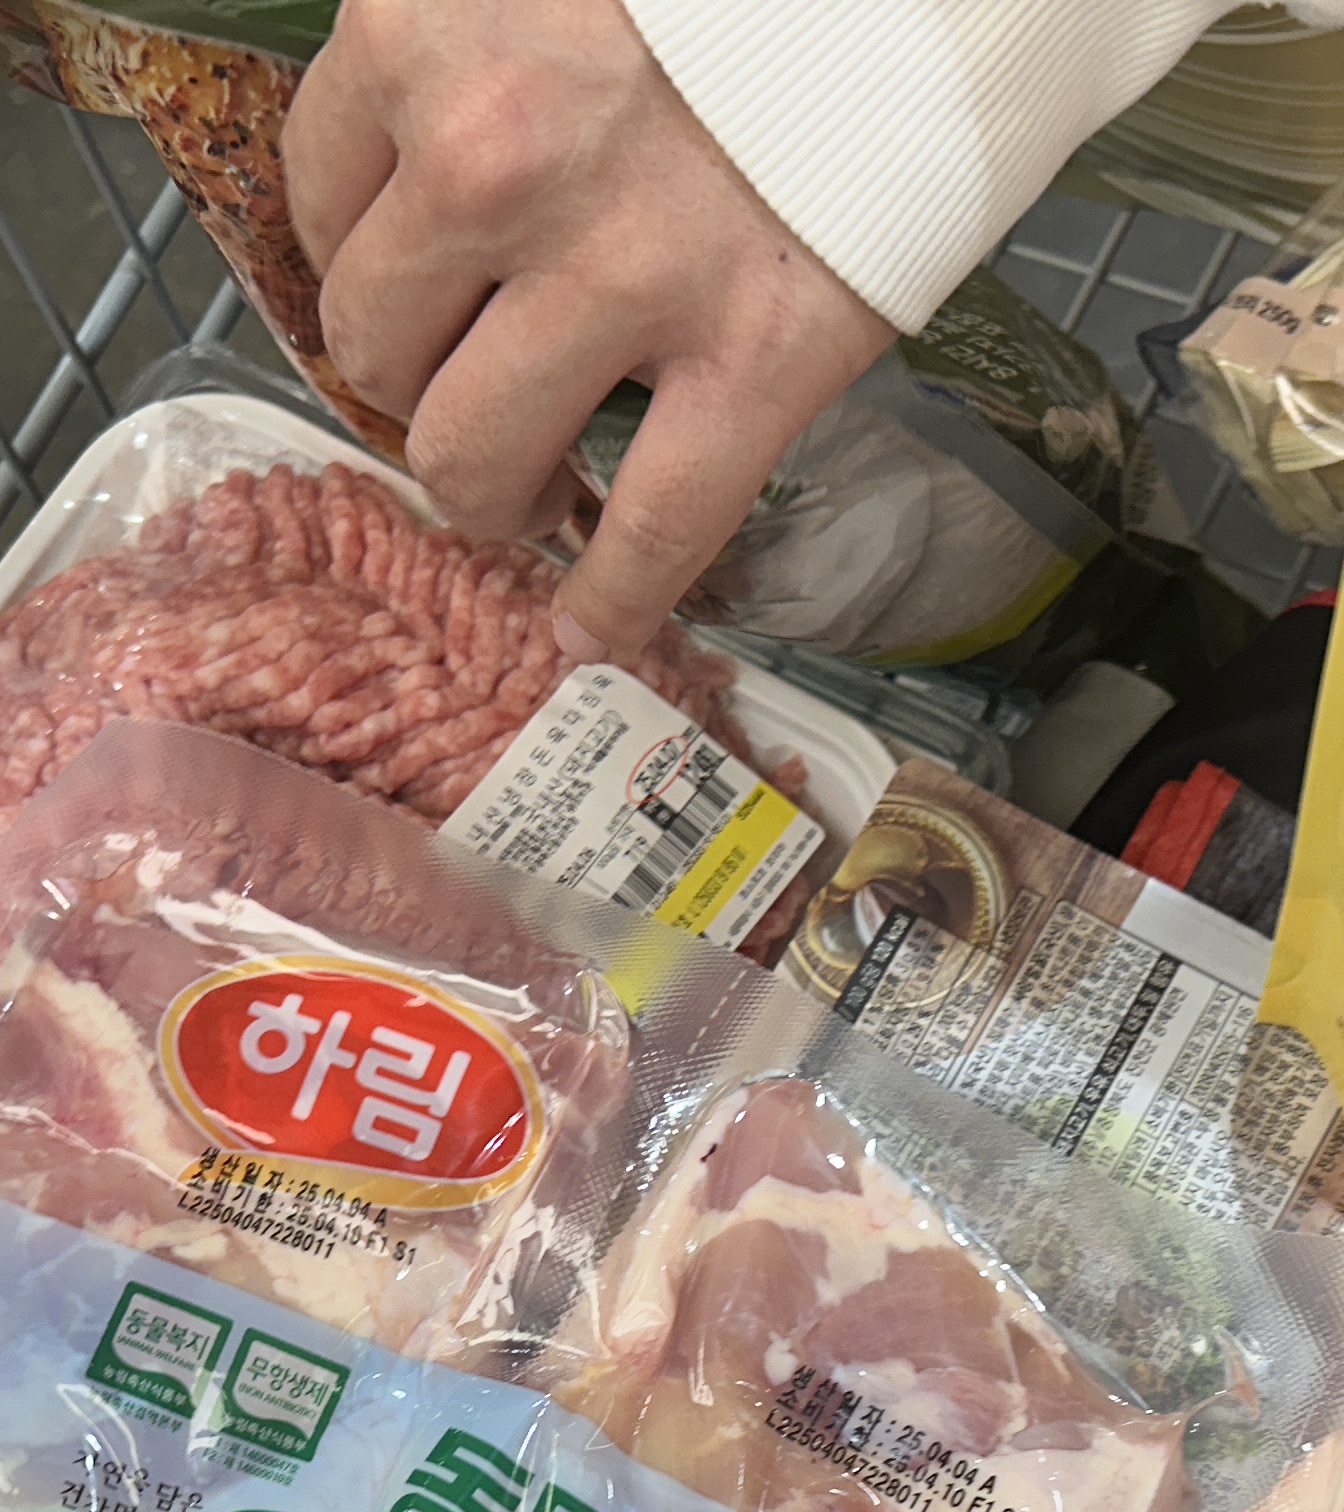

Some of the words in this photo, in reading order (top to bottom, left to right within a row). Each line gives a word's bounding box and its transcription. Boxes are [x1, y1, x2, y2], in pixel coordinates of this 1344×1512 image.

[239, 992, 472, 1162] 하림
[373, 1206, 389, 1229] A
[126, 1308, 211, 1361] 동물복지
[246, 1355, 330, 1407] 무항생제
[895, 1423, 980, 1486] 25.04.04
[978, 1474, 999, 1496] A
